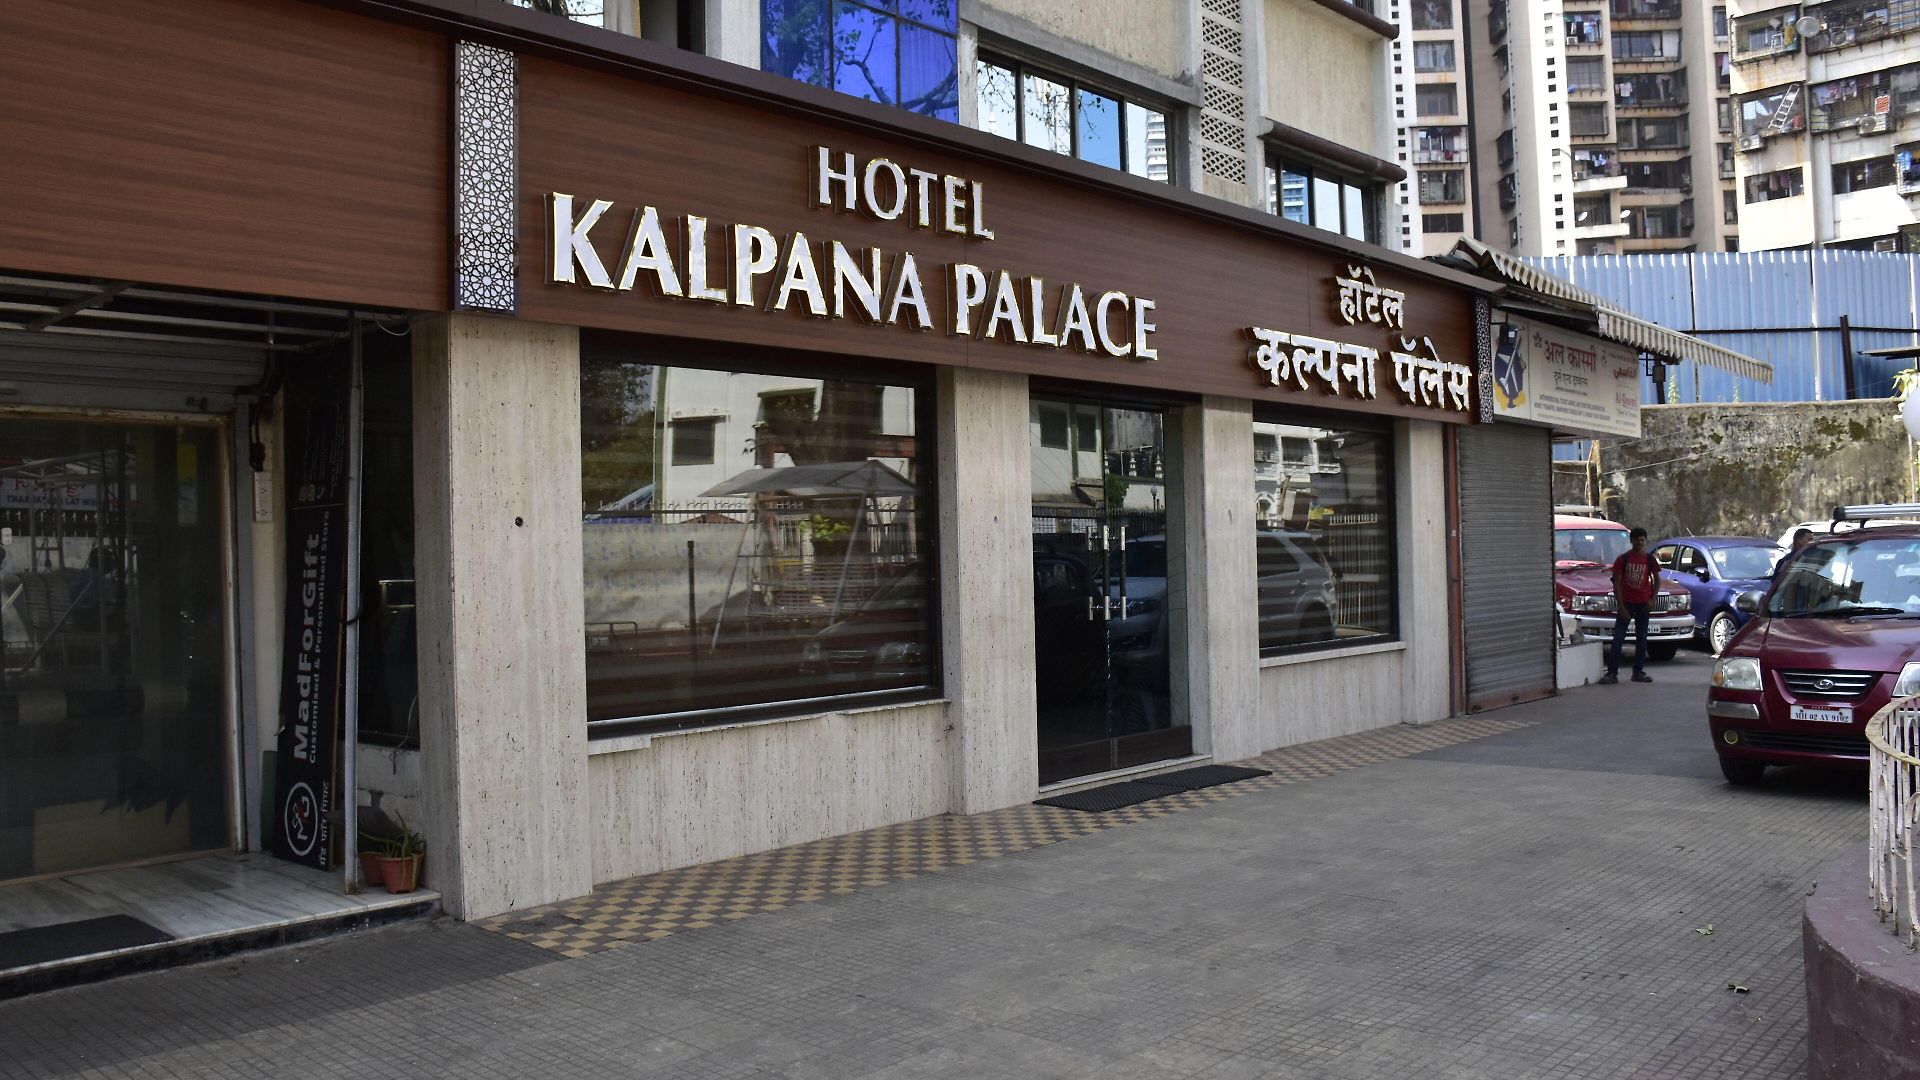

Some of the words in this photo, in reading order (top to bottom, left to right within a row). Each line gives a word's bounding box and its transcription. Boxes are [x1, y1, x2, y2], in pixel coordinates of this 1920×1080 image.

[816, 145, 995, 241] HOTEL
[551, 191, 935, 331] KALPANA
[953, 263, 1160, 362] PALACE
[1335, 264, 1406, 330] हॉटेल
[1251, 326, 1379, 400] कल्पना
[1389, 335, 1473, 412] पॅलेस
[319, 510, 330, 551] Store
[293, 532, 320, 760] MadForGift
[314, 555, 327, 653] Personalised
[313, 657, 321, 669] &
[309, 673, 321, 764] Customised
[1795, 712, 1807, 720] MH
